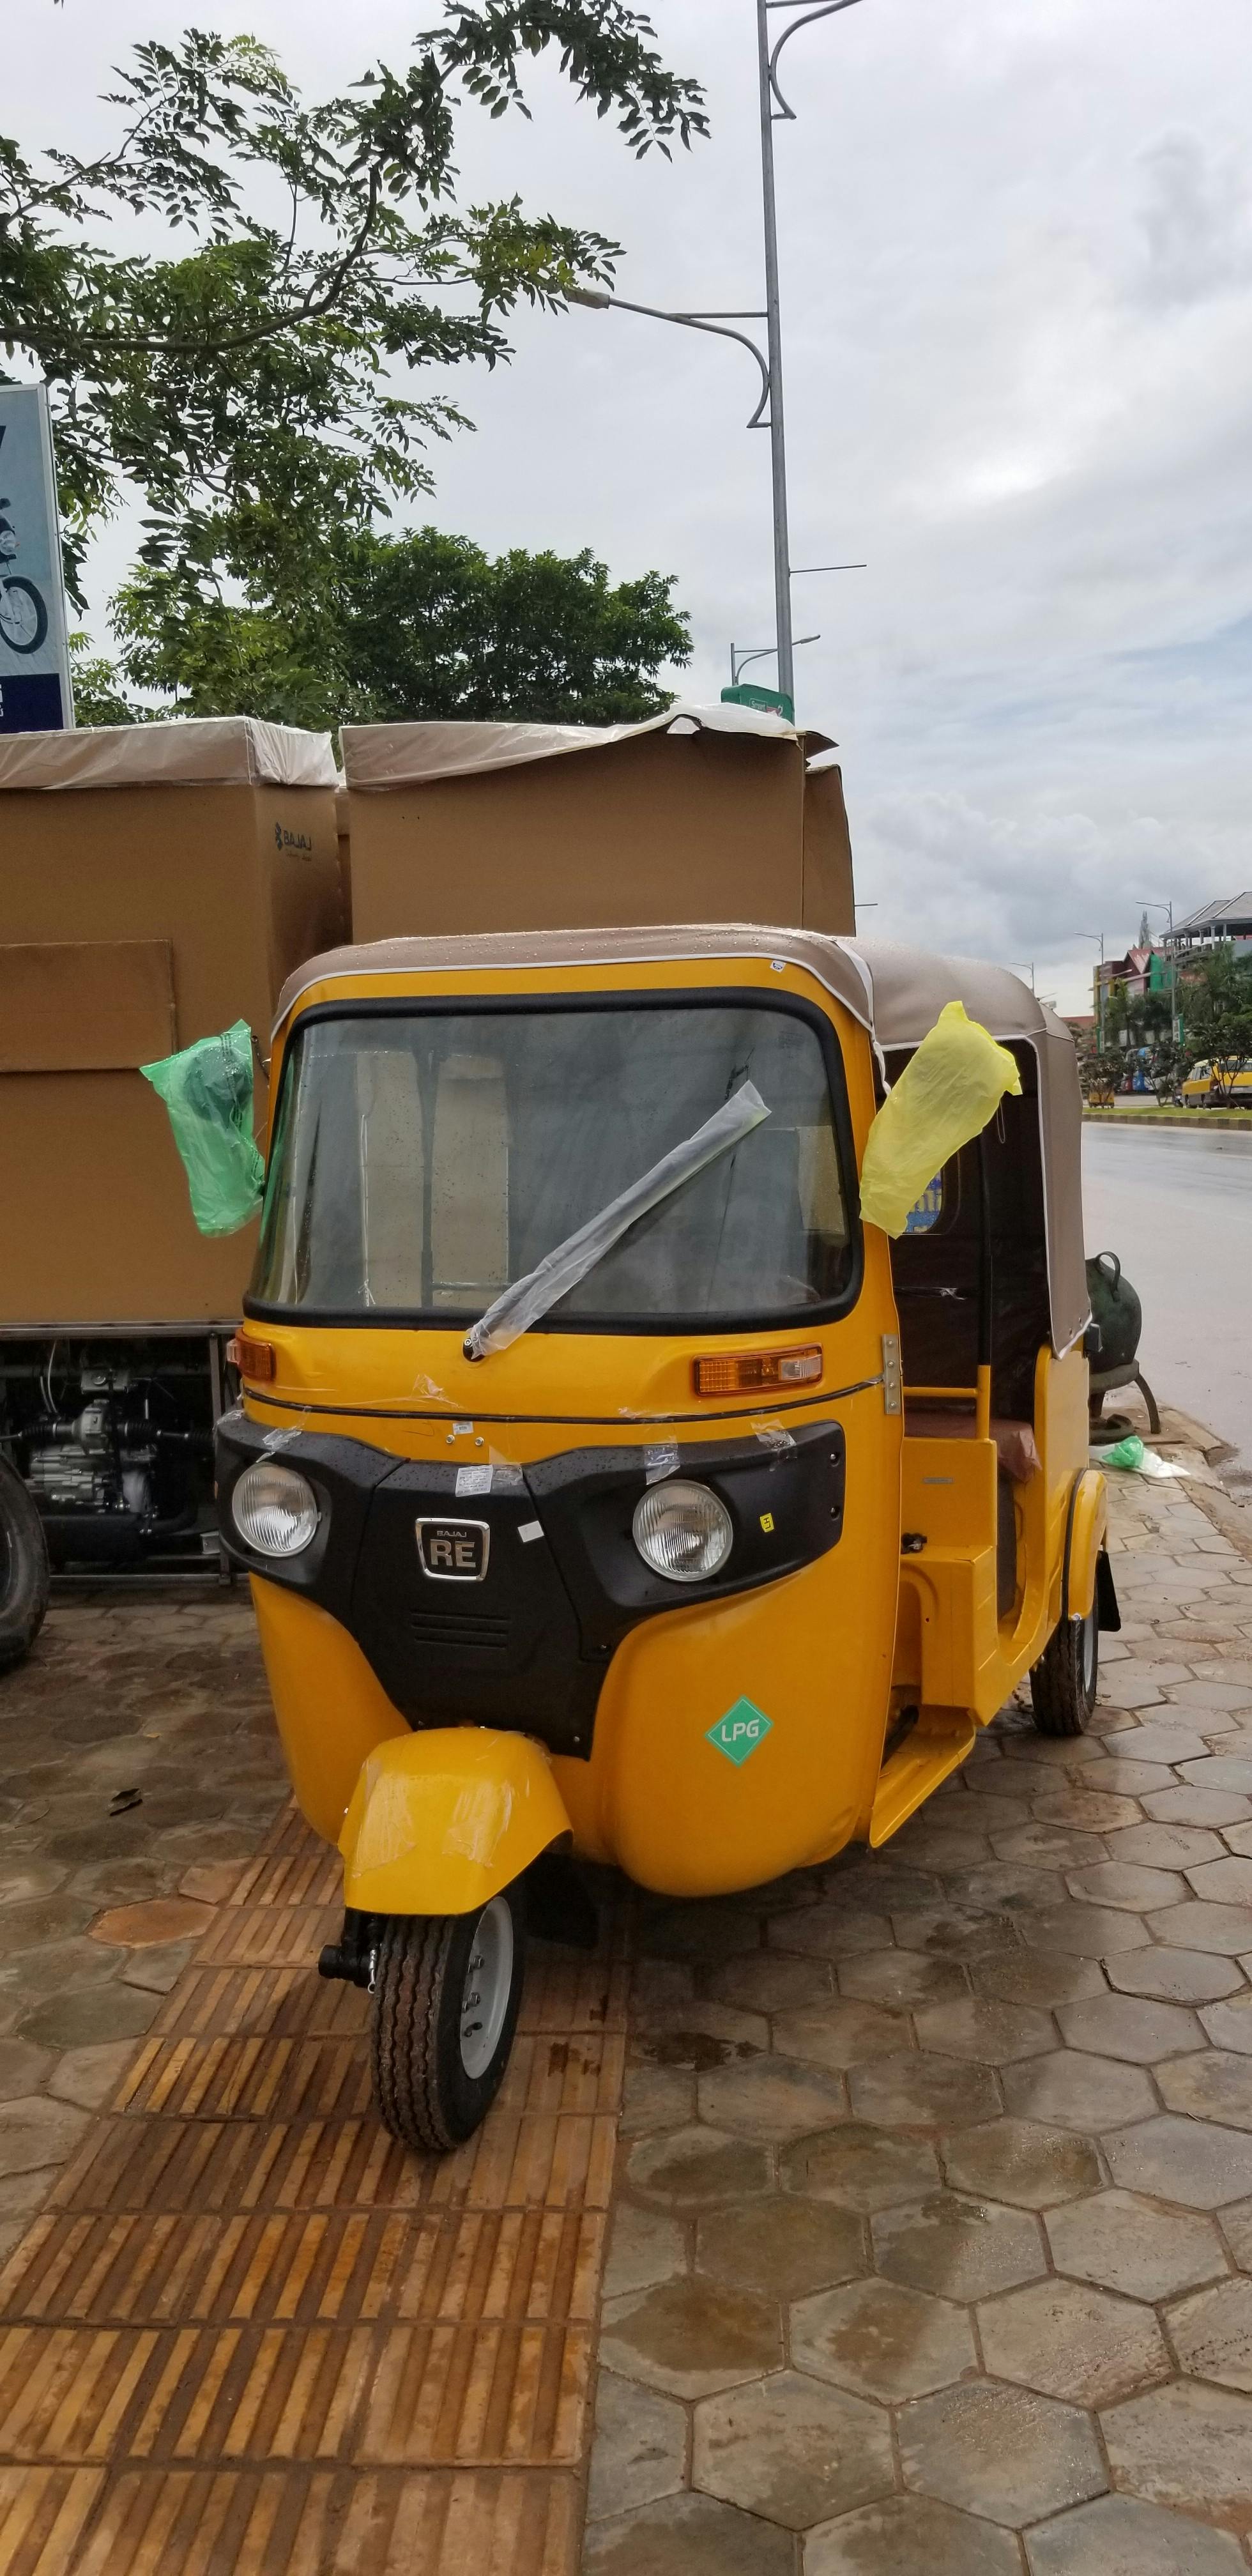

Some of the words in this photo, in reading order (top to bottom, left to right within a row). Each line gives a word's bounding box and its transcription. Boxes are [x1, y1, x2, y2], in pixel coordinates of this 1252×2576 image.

[284, 830, 312, 851] BAJAJ
[763, 1517, 771, 1529] LH
[430, 1538, 476, 1568] RE
[721, 1719, 760, 1742] LPG
